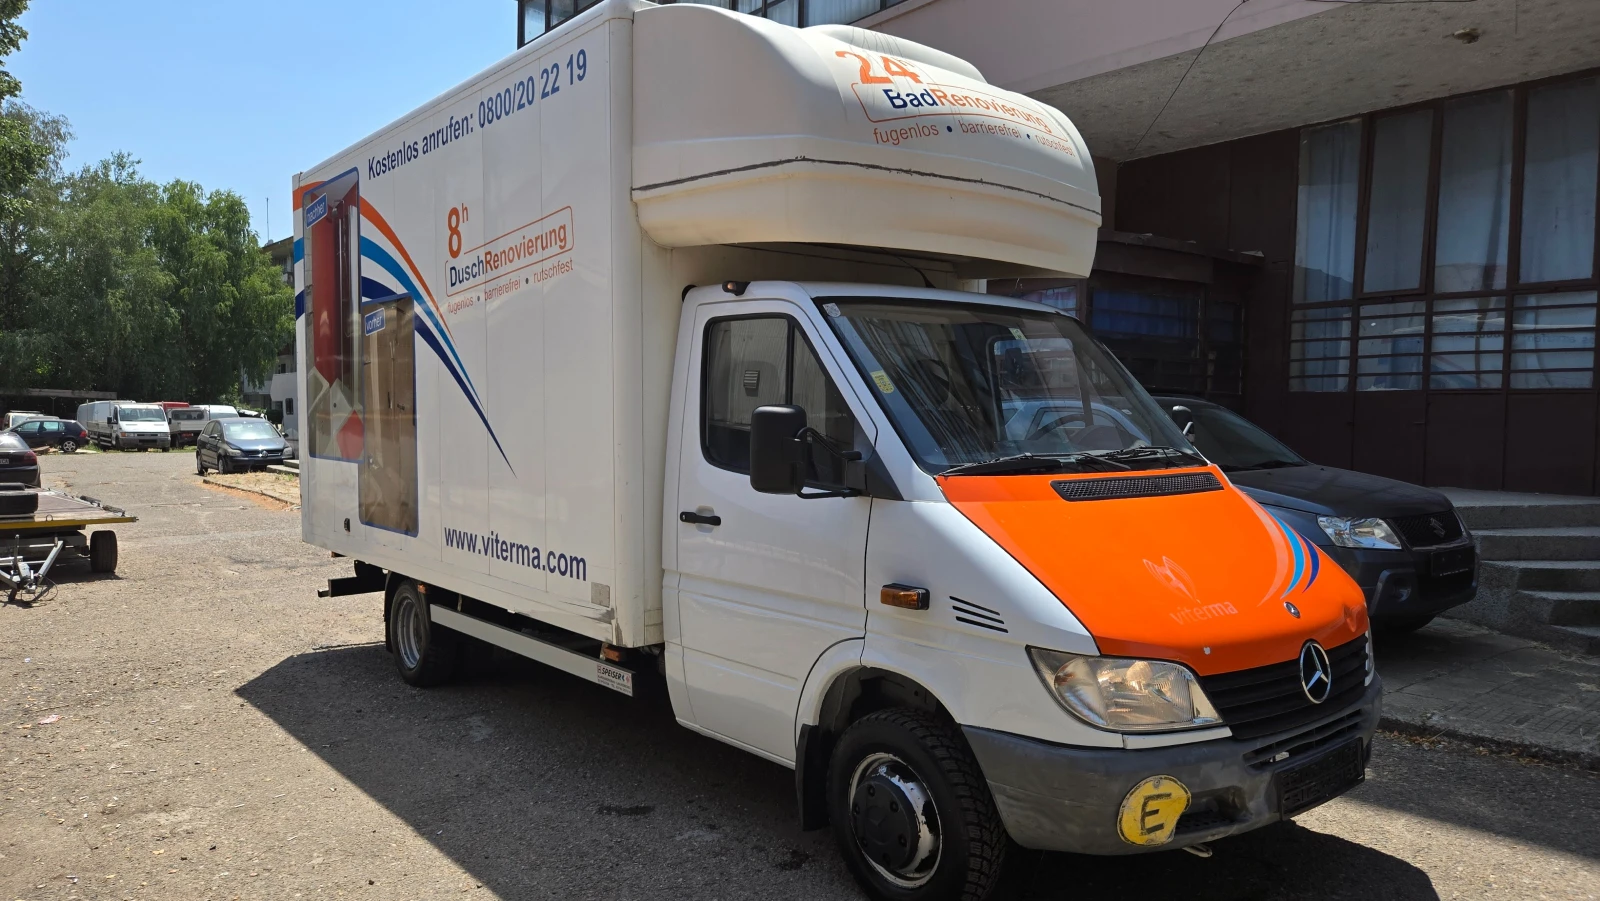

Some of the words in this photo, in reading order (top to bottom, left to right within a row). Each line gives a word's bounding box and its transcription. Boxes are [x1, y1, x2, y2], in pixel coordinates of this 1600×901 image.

[368, 141, 419, 180] Kostenlos
[422, 113, 474, 155] anrufen:
[478, 75, 535, 129] 0800/20
[541, 62, 560, 99] 22
[566, 48, 587, 86] 19
[873, 123, 939, 145] fugenlos
[958, 120, 1022, 139] barrierefrei
[882, 88, 1052, 134] BadRenovierung
[449, 223, 567, 288] DuschRenovierung
[447, 296, 474, 315] fugenlos
[484, 276, 521, 301] barrierefrei
[533, 257, 574, 284] rutschfest
[444, 527, 587, 582] www.viterma.com
[1169, 601, 1239, 625] viterma
[1139, 792, 1172, 836] E
